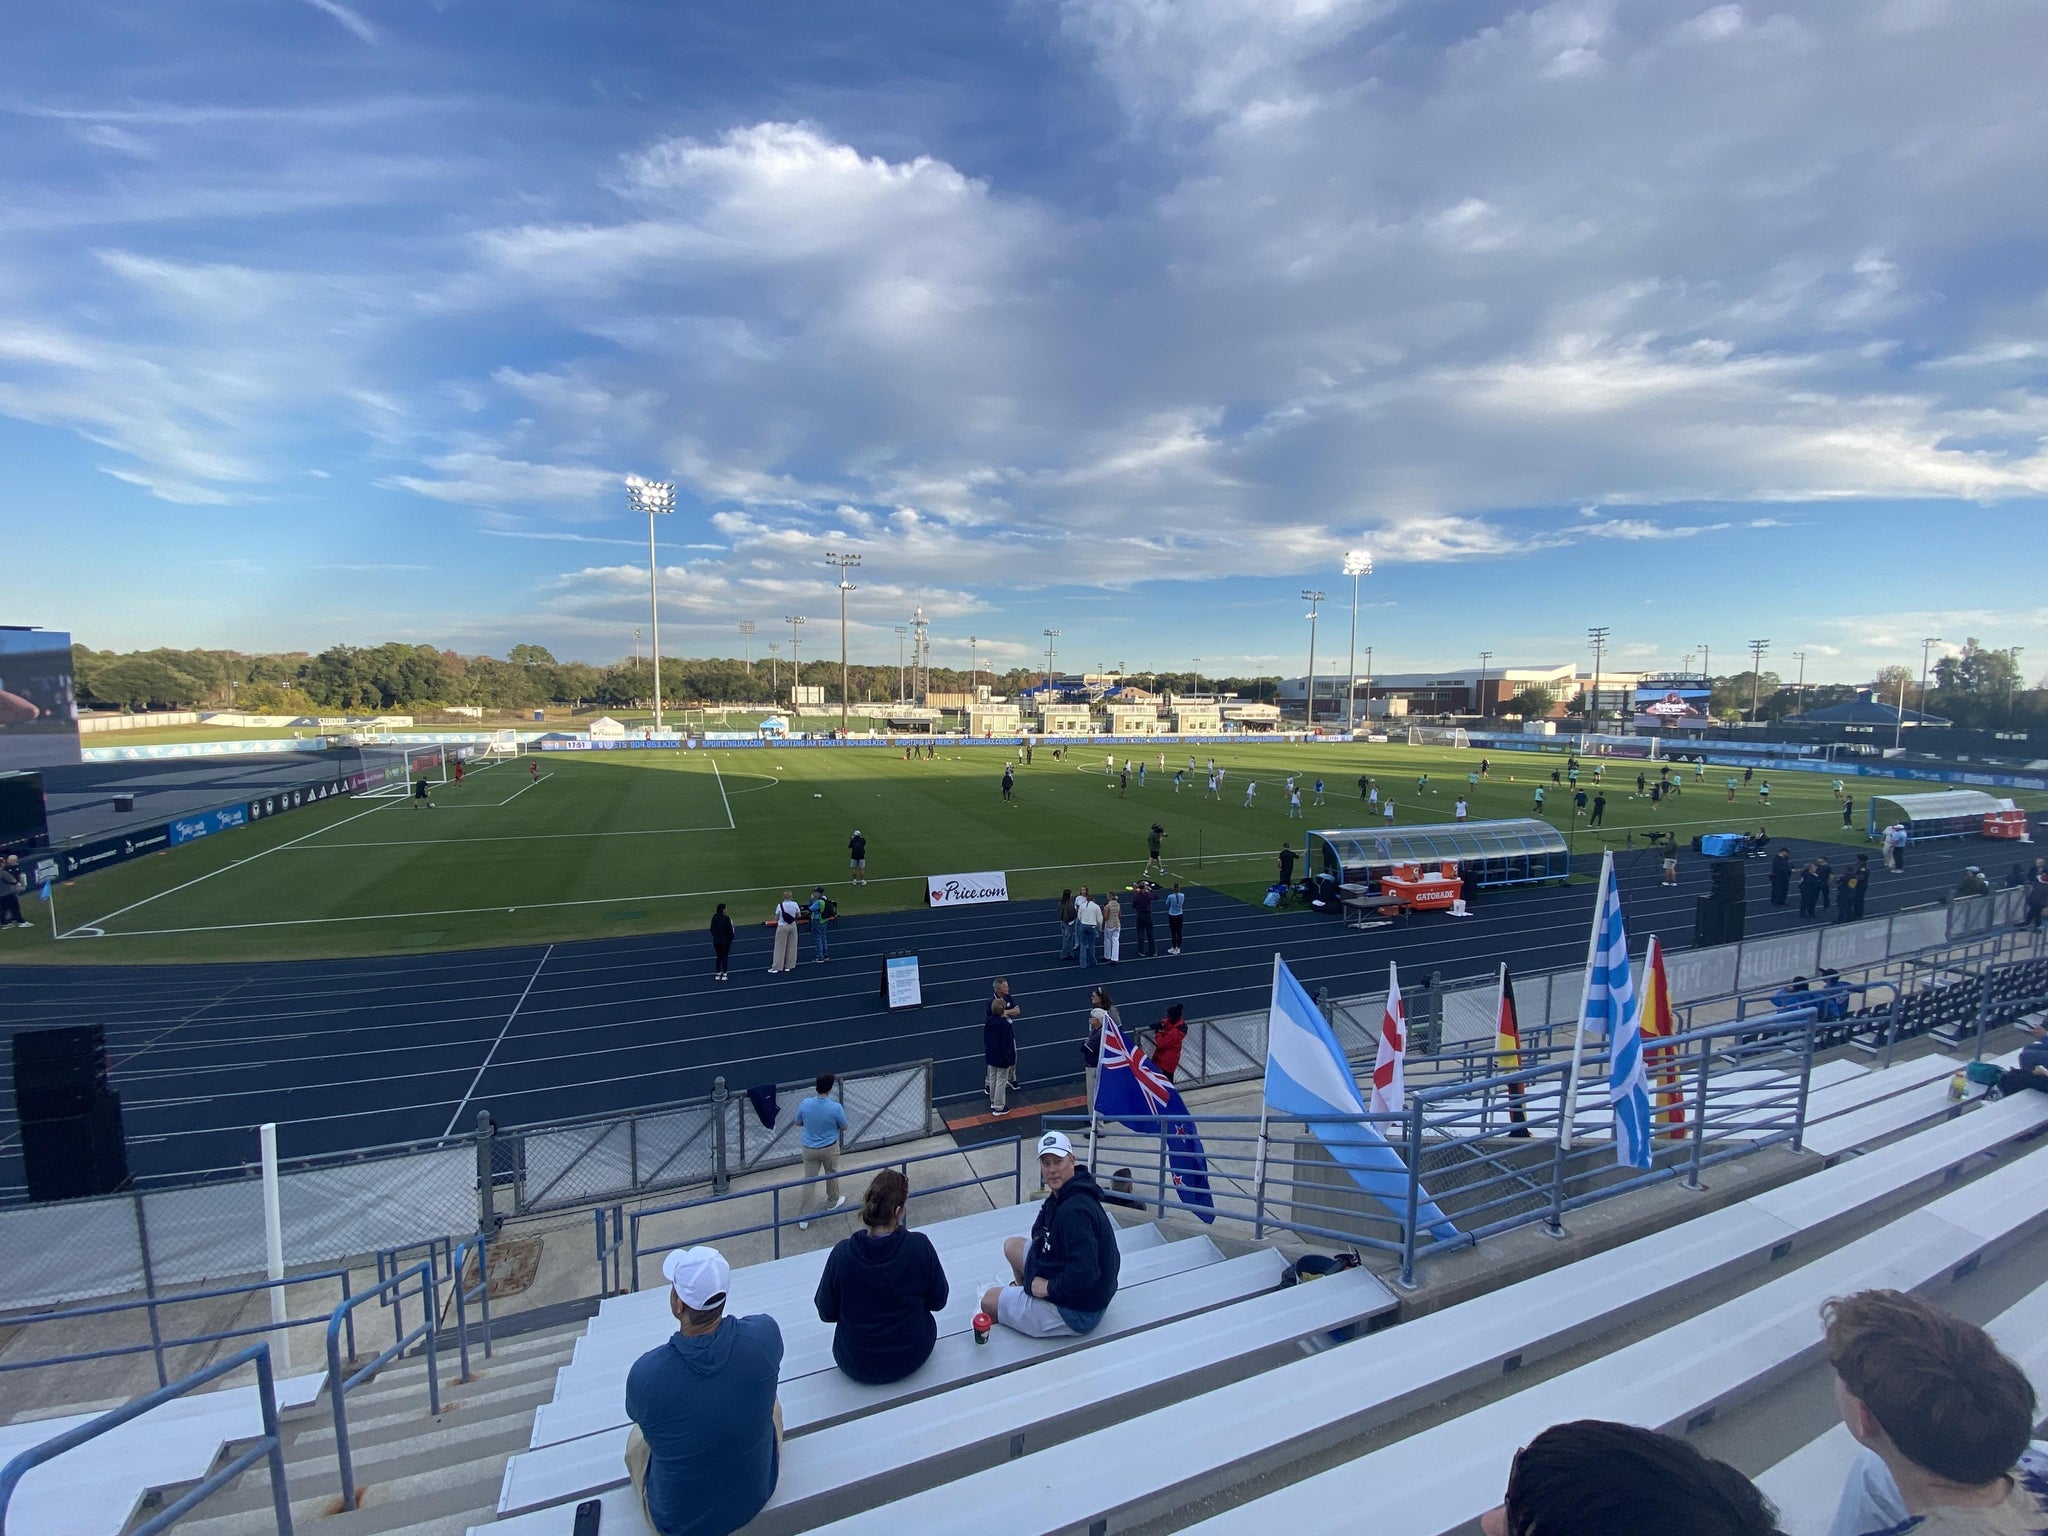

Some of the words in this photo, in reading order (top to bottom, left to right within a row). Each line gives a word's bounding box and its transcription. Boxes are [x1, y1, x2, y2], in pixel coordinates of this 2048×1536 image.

[567, 741, 585, 749] 17:51
[631, 741, 681, 749] 904.863.KICK
[702, 740, 765, 748] SPORTINGJAX.COM
[944, 880, 1006, 901] Price.com
[1416, 890, 1454, 902] GATORADE
